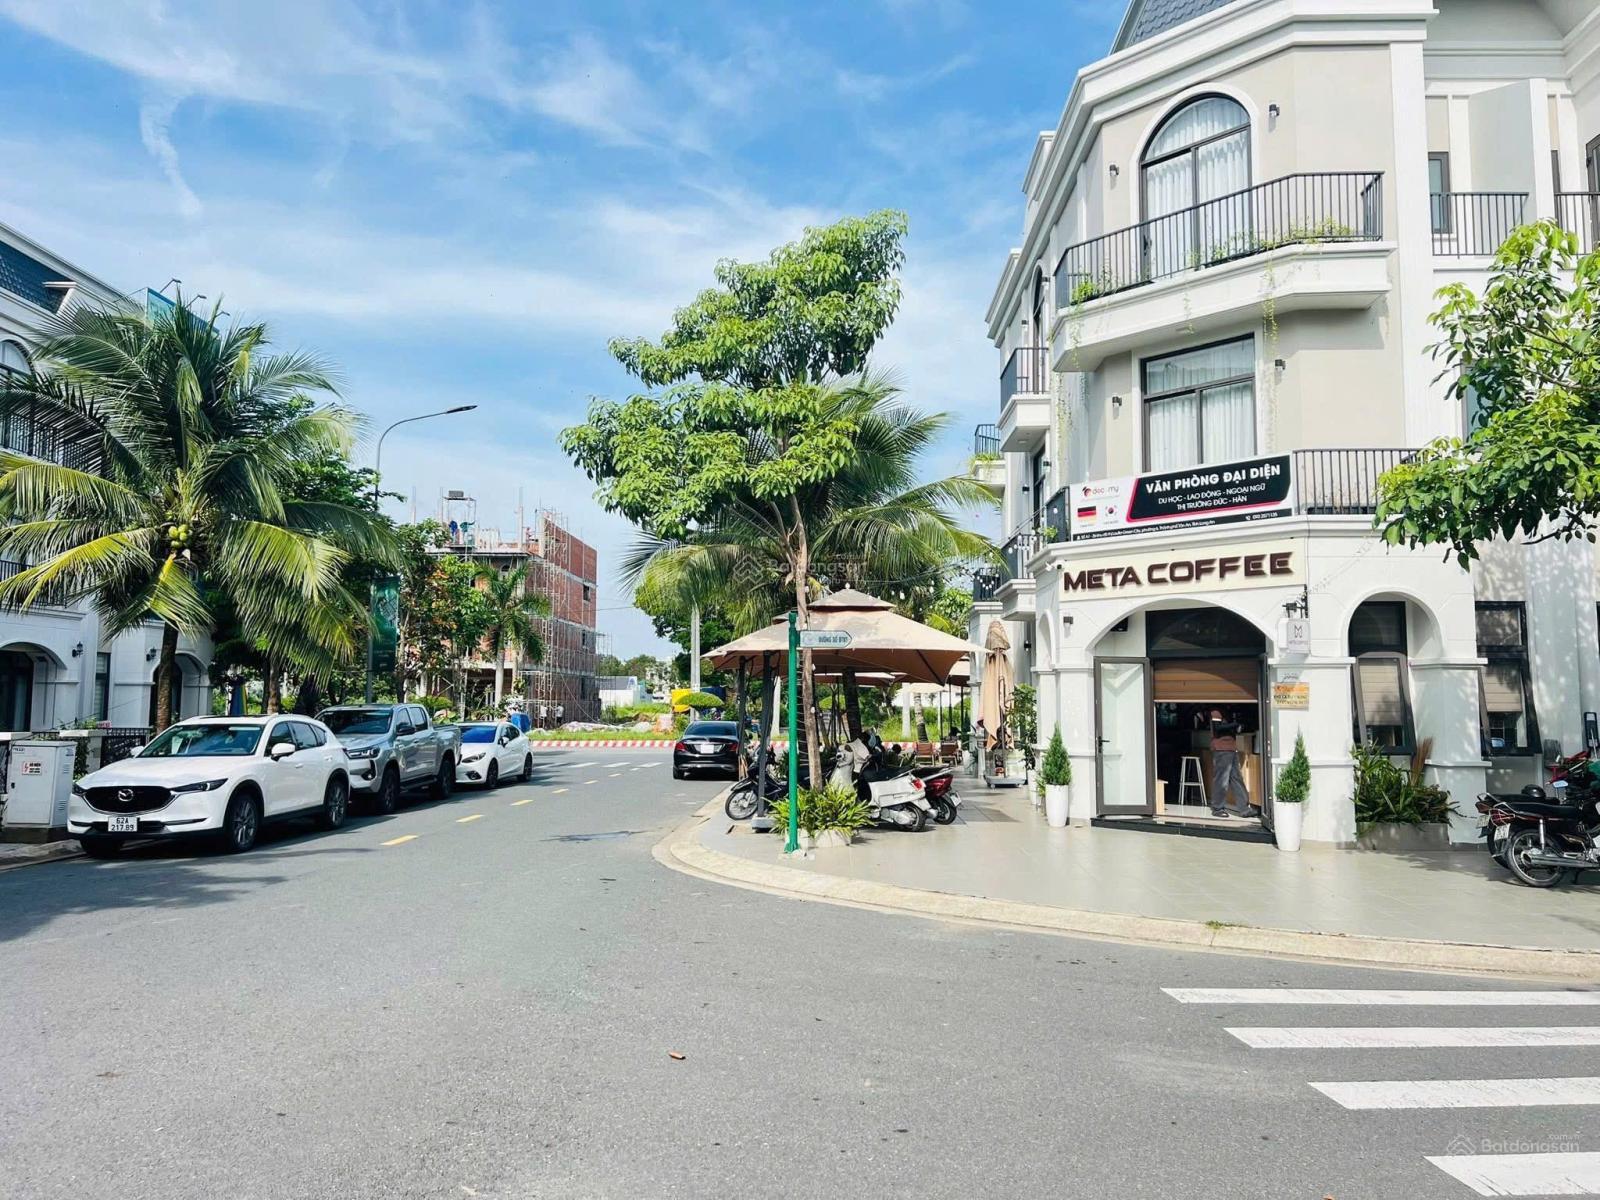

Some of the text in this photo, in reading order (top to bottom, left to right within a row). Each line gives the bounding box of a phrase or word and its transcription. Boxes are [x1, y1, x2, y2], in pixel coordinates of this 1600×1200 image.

[1146, 463, 1281, 494] VĂN PHÒNG ĐẠI DIỆN
[1168, 494, 1183, 503] HỌC
[1187, 493, 1200, 501] LAO
[1201, 489, 1222, 500] ĐỘNG
[1226, 486, 1249, 496] NGOẠI
[1063, 551, 1293, 591] META COFFEE
